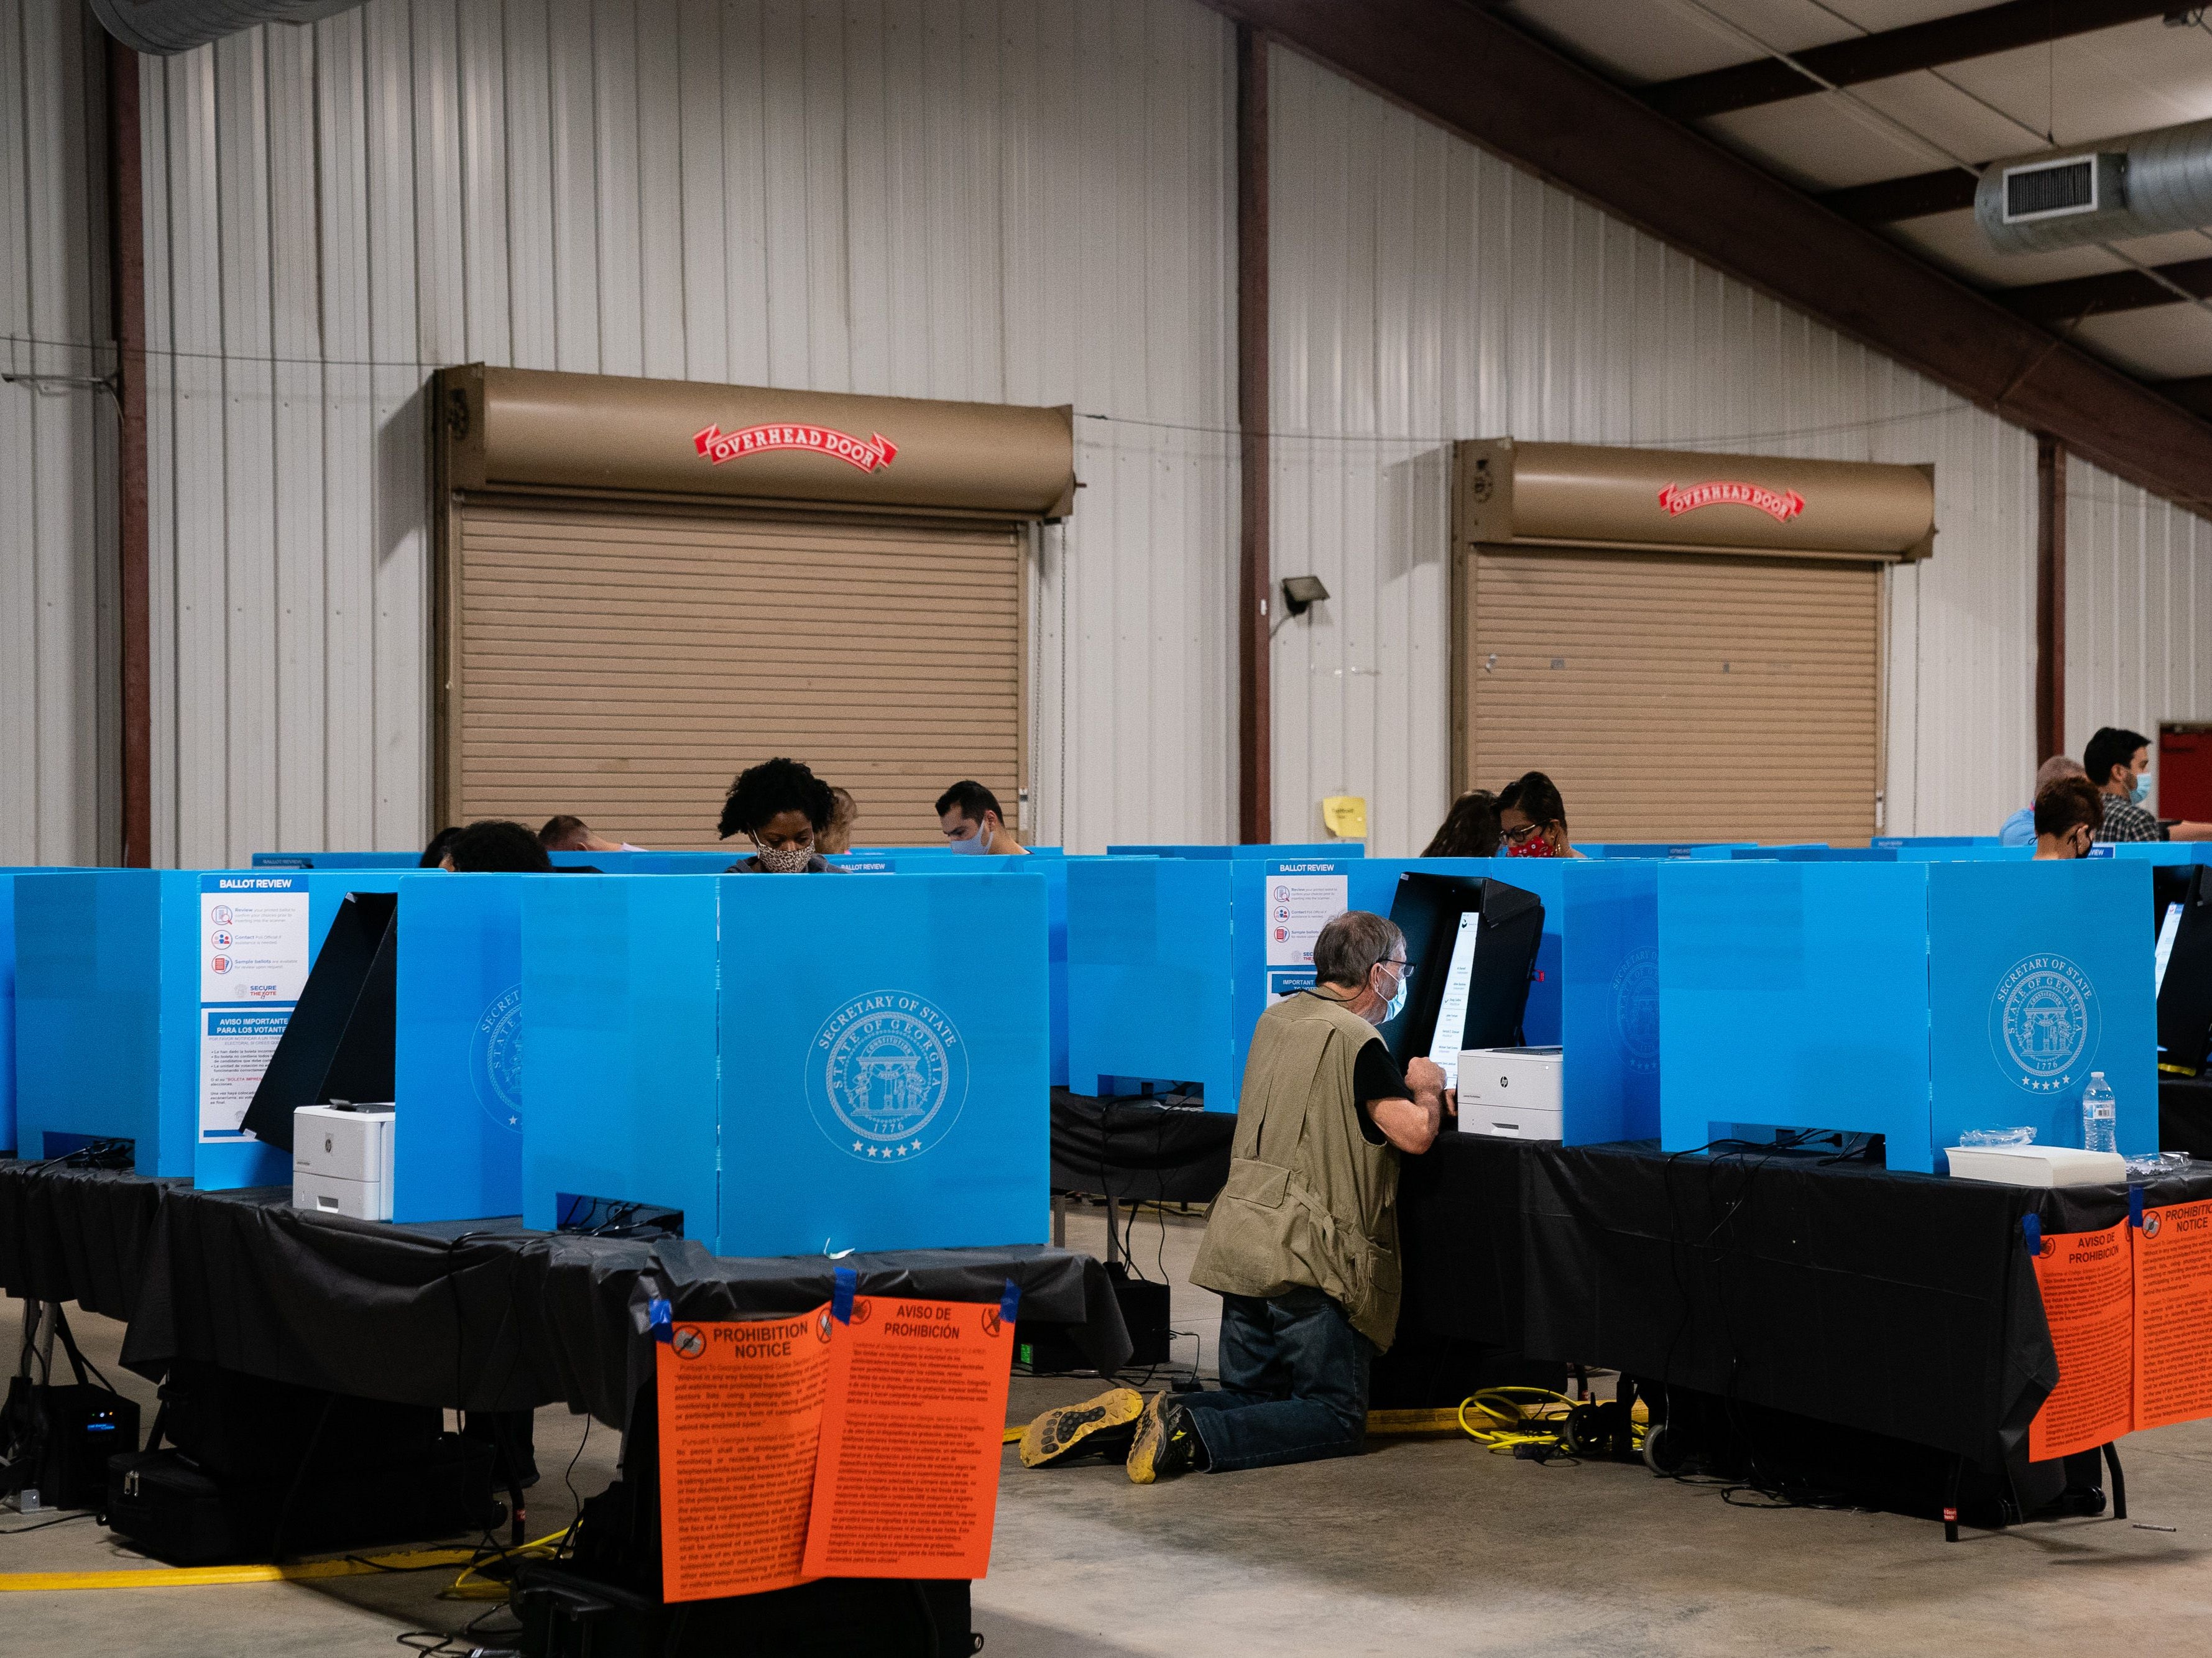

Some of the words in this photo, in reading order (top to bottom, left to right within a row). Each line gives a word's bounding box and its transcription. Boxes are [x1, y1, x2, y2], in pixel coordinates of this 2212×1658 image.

[716, 427, 821, 458] OVERHEAD
[826, 435, 875, 467] DOOR
[1674, 486, 1750, 512] OVERHEAD
[1753, 490, 1789, 515] DOOR
[219, 880, 255, 888] BALLOT
[256, 879, 292, 888] REVIEW
[1613, 949, 1649, 990] SECRETARY
[1998, 958, 2048, 1002] SECRETARY
[2052, 959, 2065, 971] OF
[2067, 967, 2092, 1000] STATE
[2008, 987, 2025, 1034] STATE
[2029, 977, 2041, 989] OF
[2047, 977, 2082, 1032] GEORGIA
[2030, 992, 2062, 1005] CONSTITUTION
[481, 990, 519, 1033] SECRET
[819, 996, 893, 1049] SECRETARY
[899, 997, 919, 1011] OF
[920, 1006, 957, 1047] STATE
[494, 1020, 515, 1069] STATE
[866, 1038, 912, 1054] CONSTITUTION
[833, 1033, 859, 1089] STATE
[864, 1020, 882, 1034] OF
[891, 1020, 941, 1087] GEORGIA
[2036, 1061, 2058, 1069] 1776
[1500, 1076, 1508, 1088] hp
[873, 1123, 904, 1133] 1776
[2166, 1204, 2212, 1221] PROHIBITIO
[2177, 1217, 2208, 1232] NOTICE
[2078, 1235, 2105, 1248] AVISO
[2107, 1232, 2115, 1243] DE
[896, 1305, 933, 1320] AVISO
[936, 1307, 952, 1320] DE
[713, 1321, 808, 1342] PROHIBITION
[885, 1322, 960, 1339] PROHIBICIÓN
[735, 1341, 791, 1358] NOTICE
